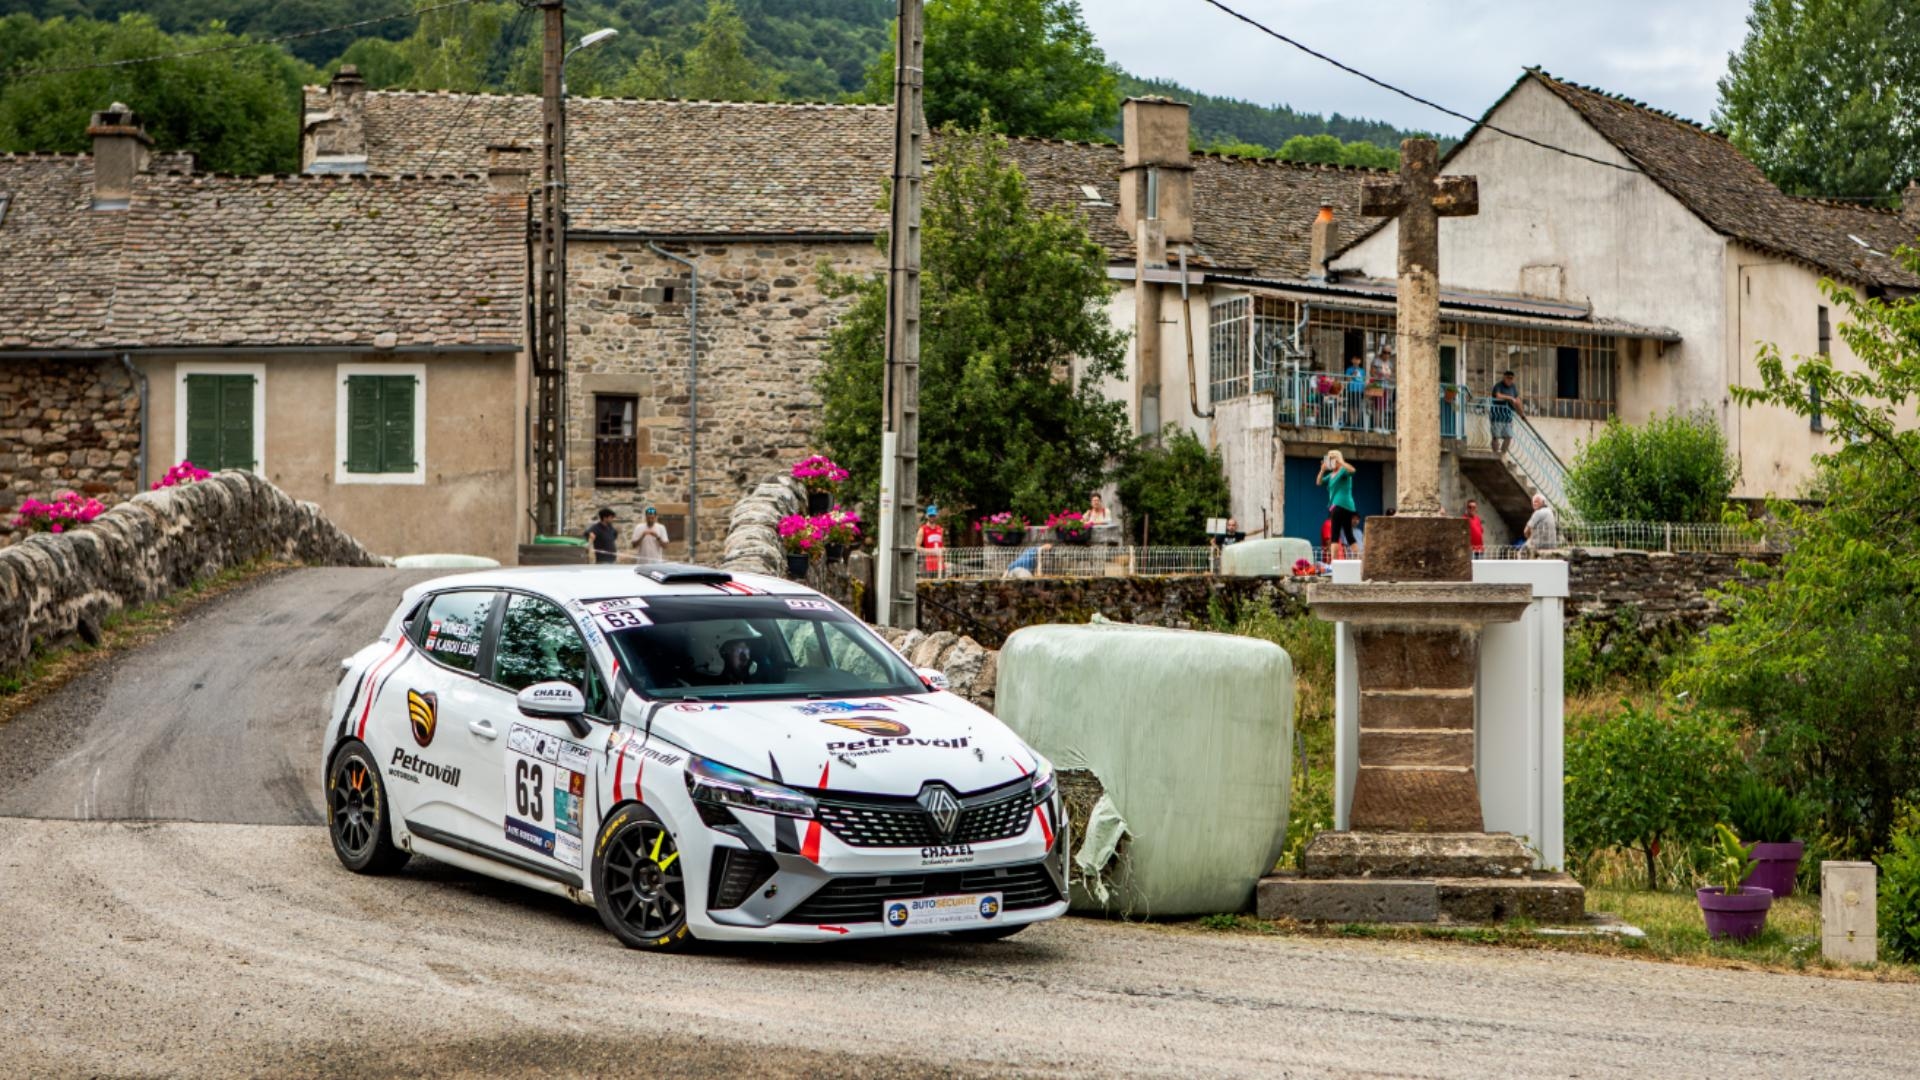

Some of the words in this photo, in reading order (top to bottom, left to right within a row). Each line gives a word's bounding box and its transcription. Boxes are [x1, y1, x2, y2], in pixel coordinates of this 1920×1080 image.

[604, 611, 641, 628] 63
[533, 689, 574, 698] CHAZEL
[390, 746, 462, 788] Petrovöll
[515, 758, 544, 822] 63
[921, 844, 975, 858] CHAZEL
